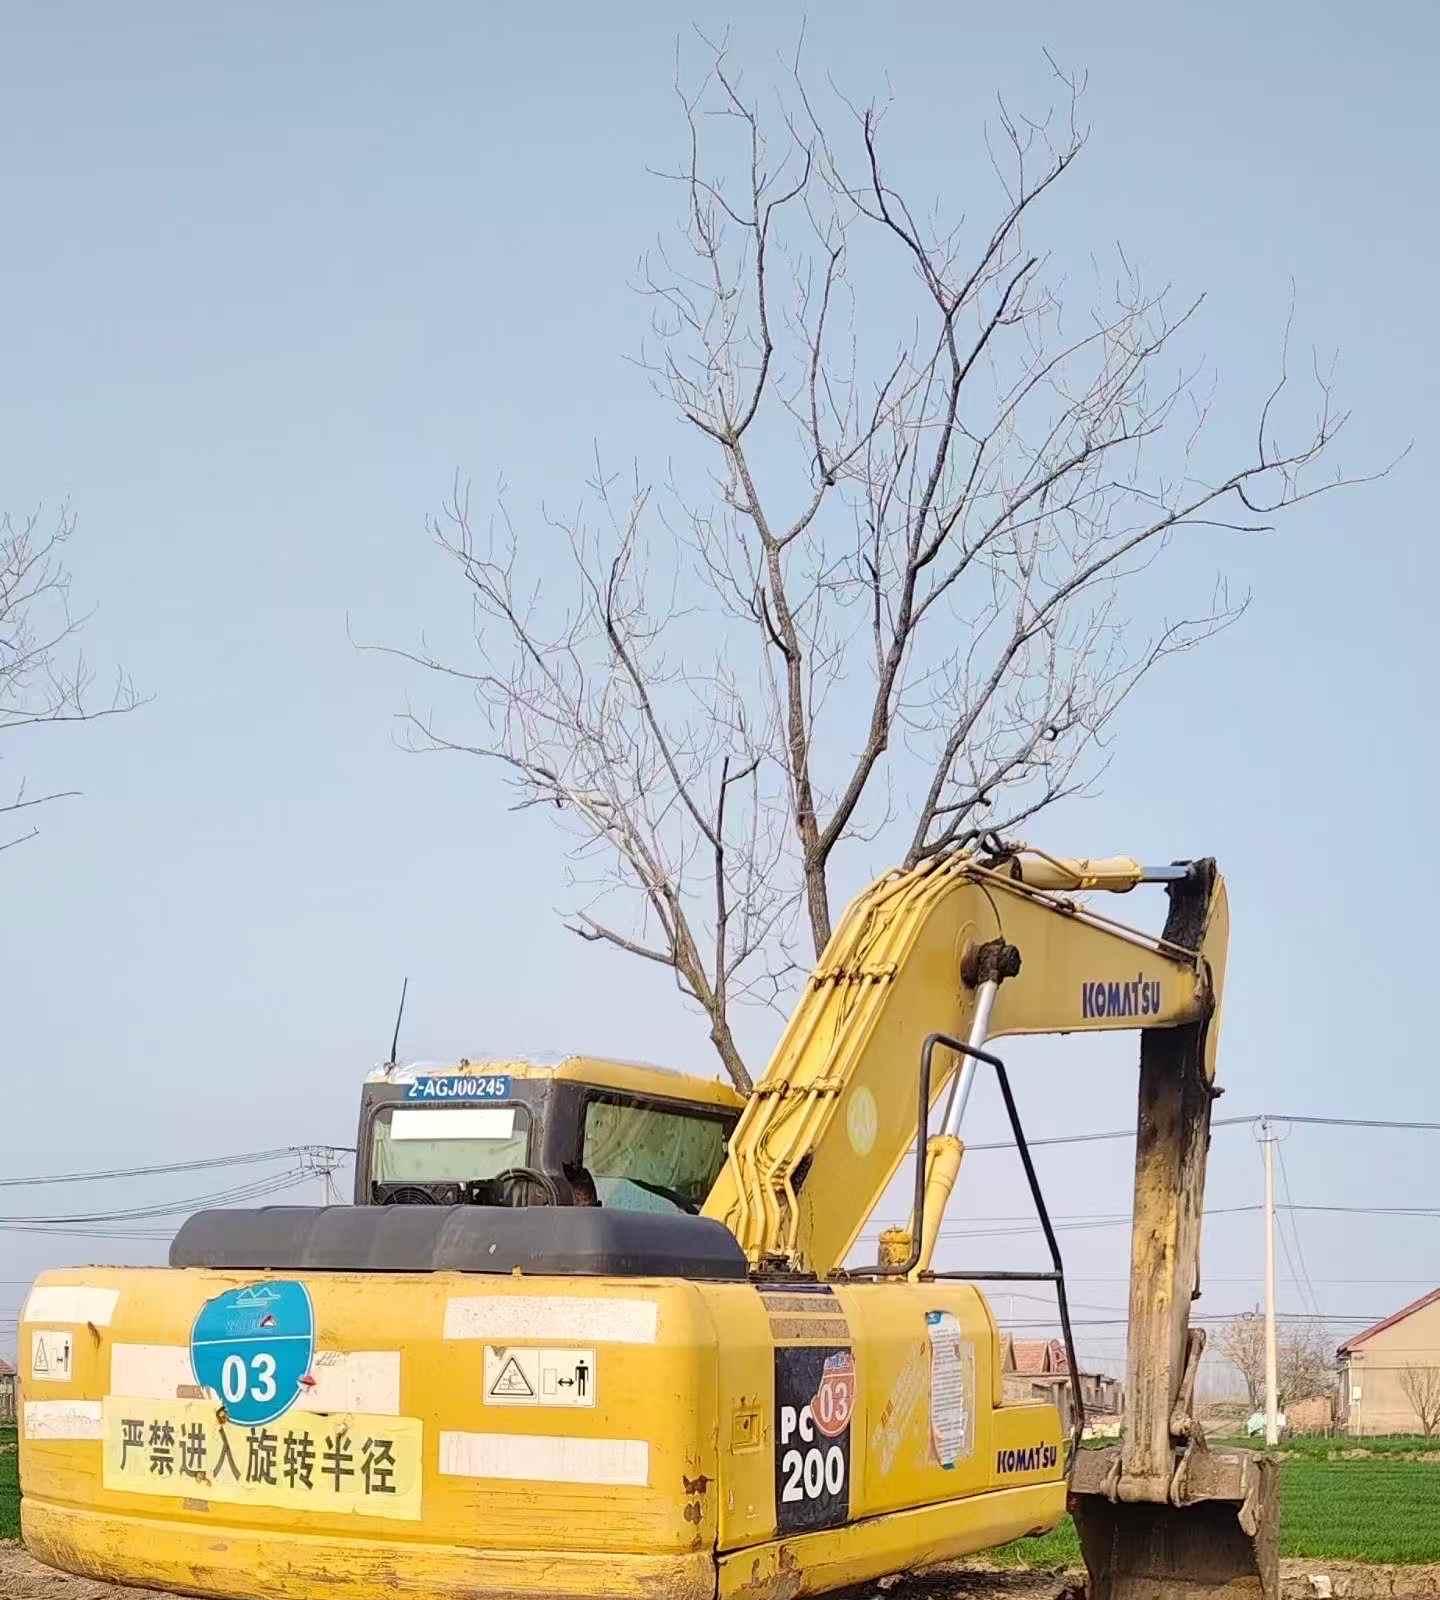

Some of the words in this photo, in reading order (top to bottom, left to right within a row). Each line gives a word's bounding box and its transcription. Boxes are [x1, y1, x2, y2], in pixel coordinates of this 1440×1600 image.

[1082, 972, 1160, 1018] KOMATSU
[408, 1078, 505, 1097] 2-AGJ00245
[221, 1352, 277, 1403] 03
[820, 1381, 848, 1422] 03
[781, 1405, 814, 1444] PC
[120, 1418, 397, 1495] 严禁进入旋转半径
[782, 1446, 845, 1502] 200
[996, 1441, 1057, 1473] KOMATSU
